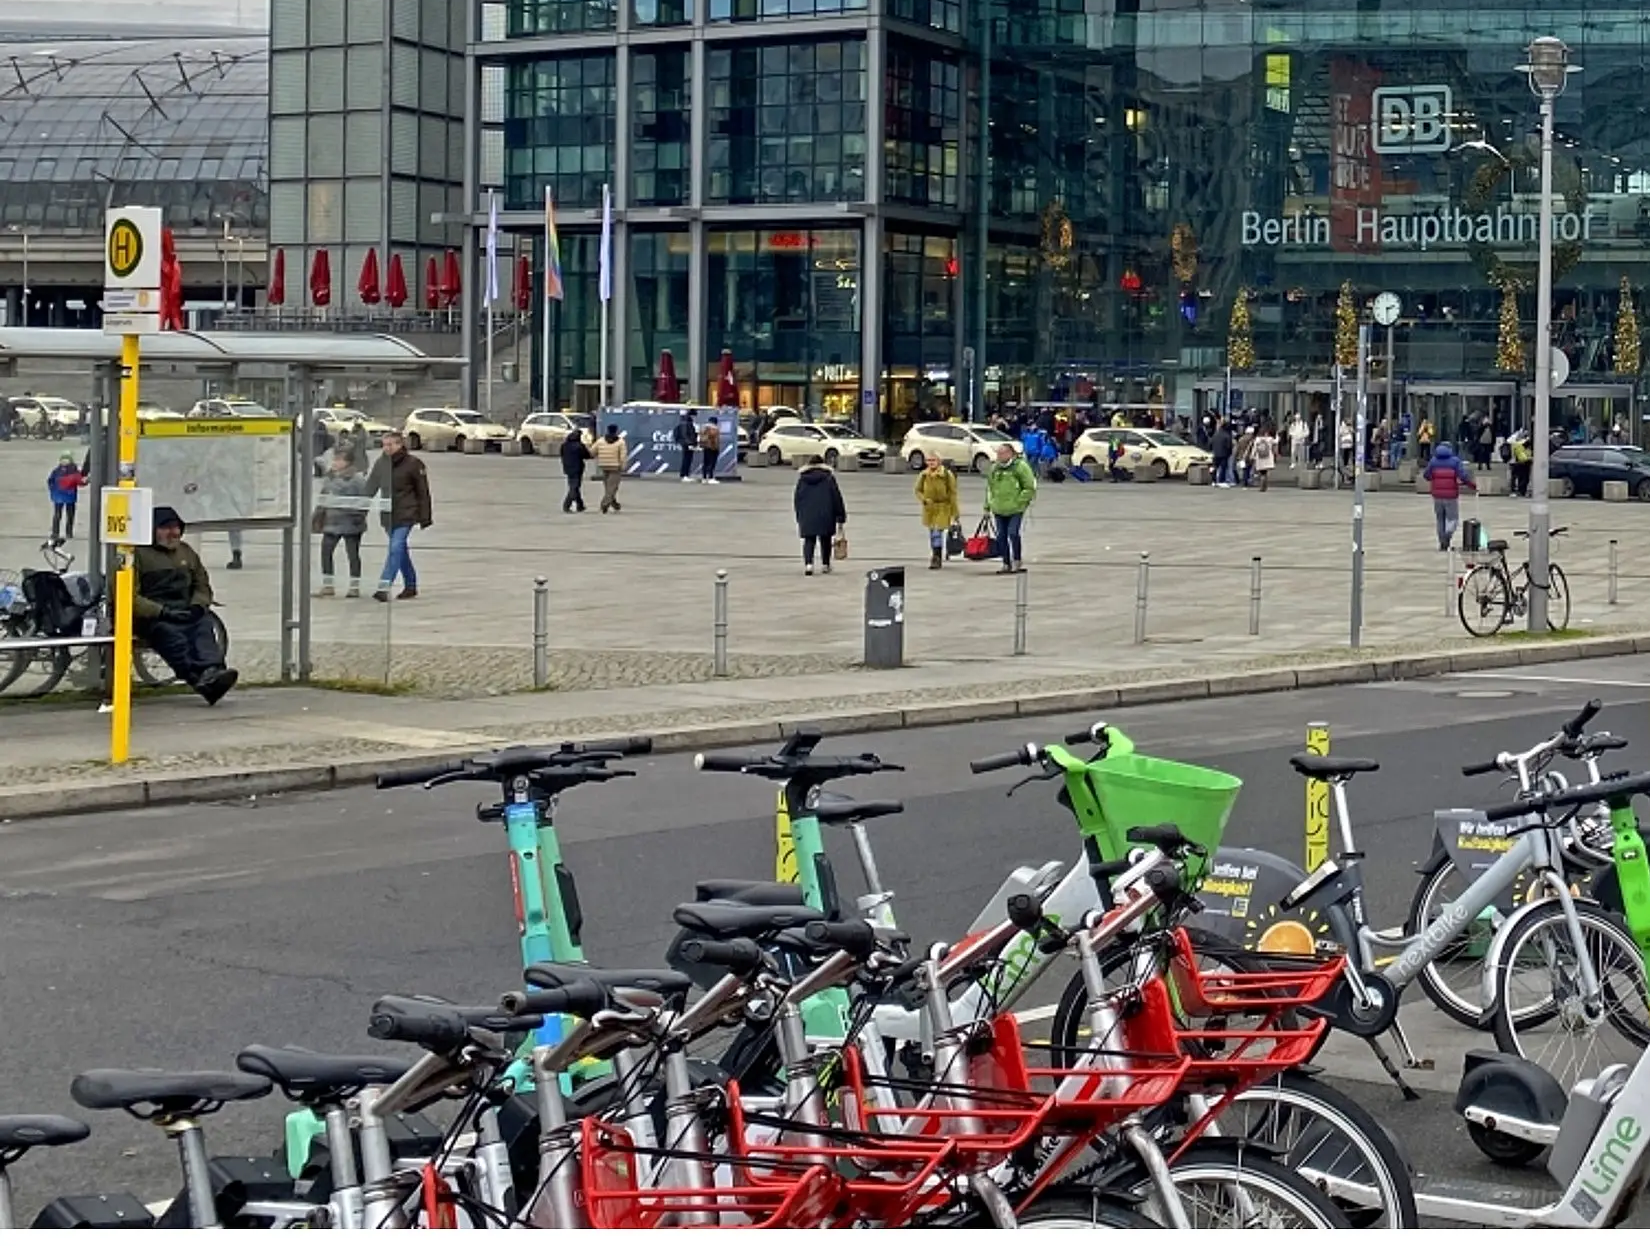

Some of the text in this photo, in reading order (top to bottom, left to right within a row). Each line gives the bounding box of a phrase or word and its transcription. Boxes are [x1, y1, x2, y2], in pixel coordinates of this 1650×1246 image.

[1381, 95, 1443, 143] DB
[116, 231, 131, 265] H
[1241, 210, 1331, 245] Berlin
[107, 515, 127, 533] BVG
[1398, 905, 1469, 977] nextbike
[1581, 1114, 1642, 1195] Lime
